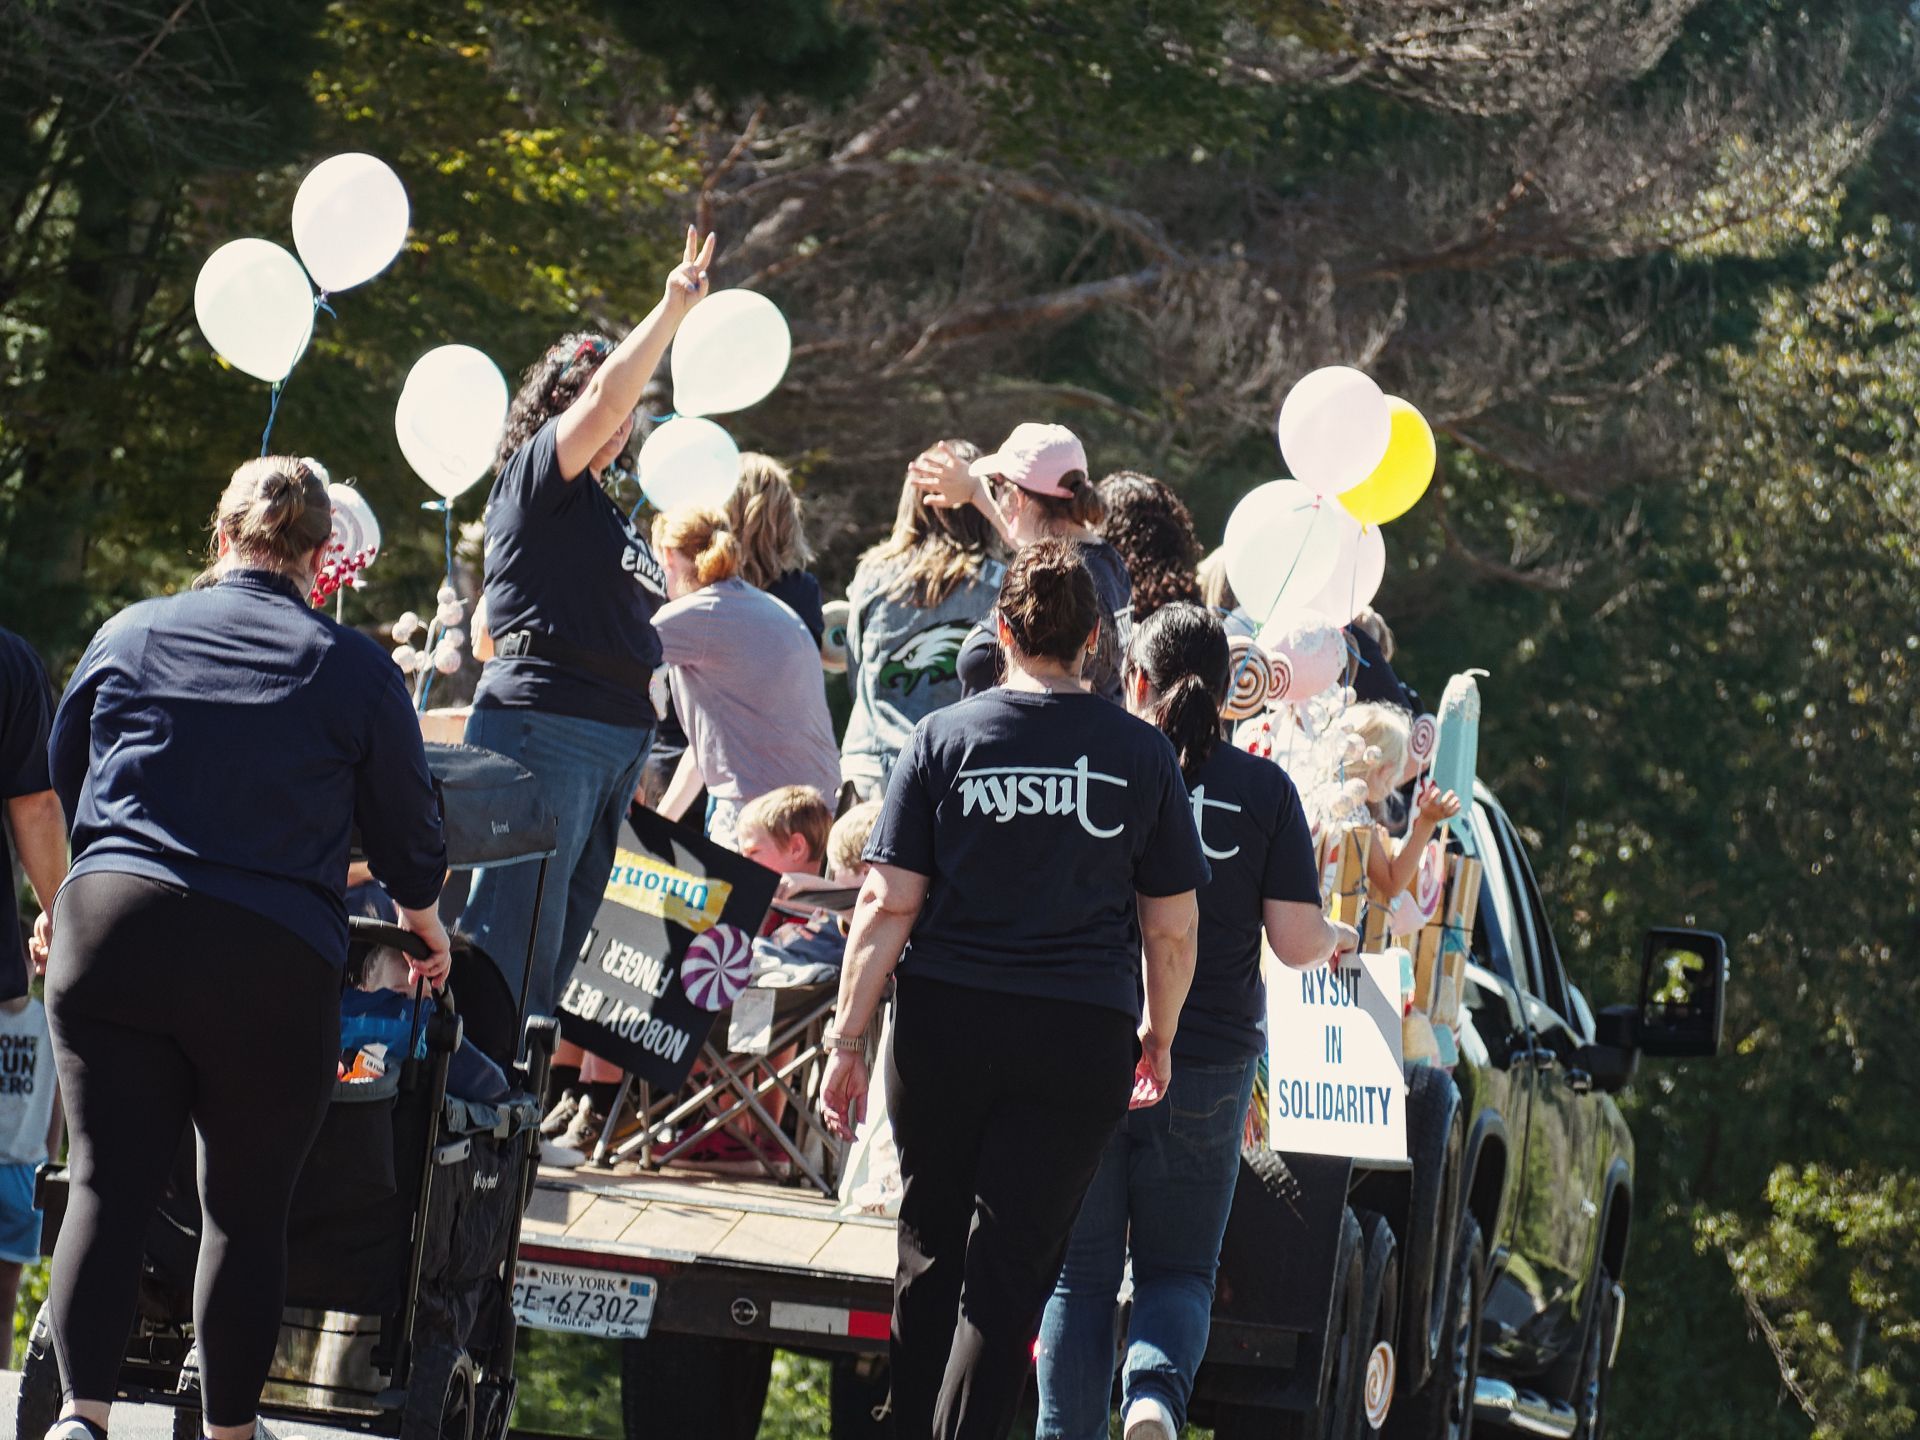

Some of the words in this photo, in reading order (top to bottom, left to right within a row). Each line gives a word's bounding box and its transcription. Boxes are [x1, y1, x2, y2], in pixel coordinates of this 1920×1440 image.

[958, 755, 1128, 838] nysut
[602, 938, 674, 999] FINGER
[1302, 967, 1361, 1007] NYSUT
[0, 1034, 38, 1051] OME
[602, 999, 690, 1064] NOBODY
[1325, 1025, 1342, 1064] IN
[0, 1053, 36, 1075] UN
[0, 1076, 34, 1097] ERO
[1279, 1079, 1391, 1125] SOLIDARITY
[541, 1270, 575, 1288] NEW
[579, 1276, 616, 1292] YORK
[547, 1315, 592, 1328] TRAILER
